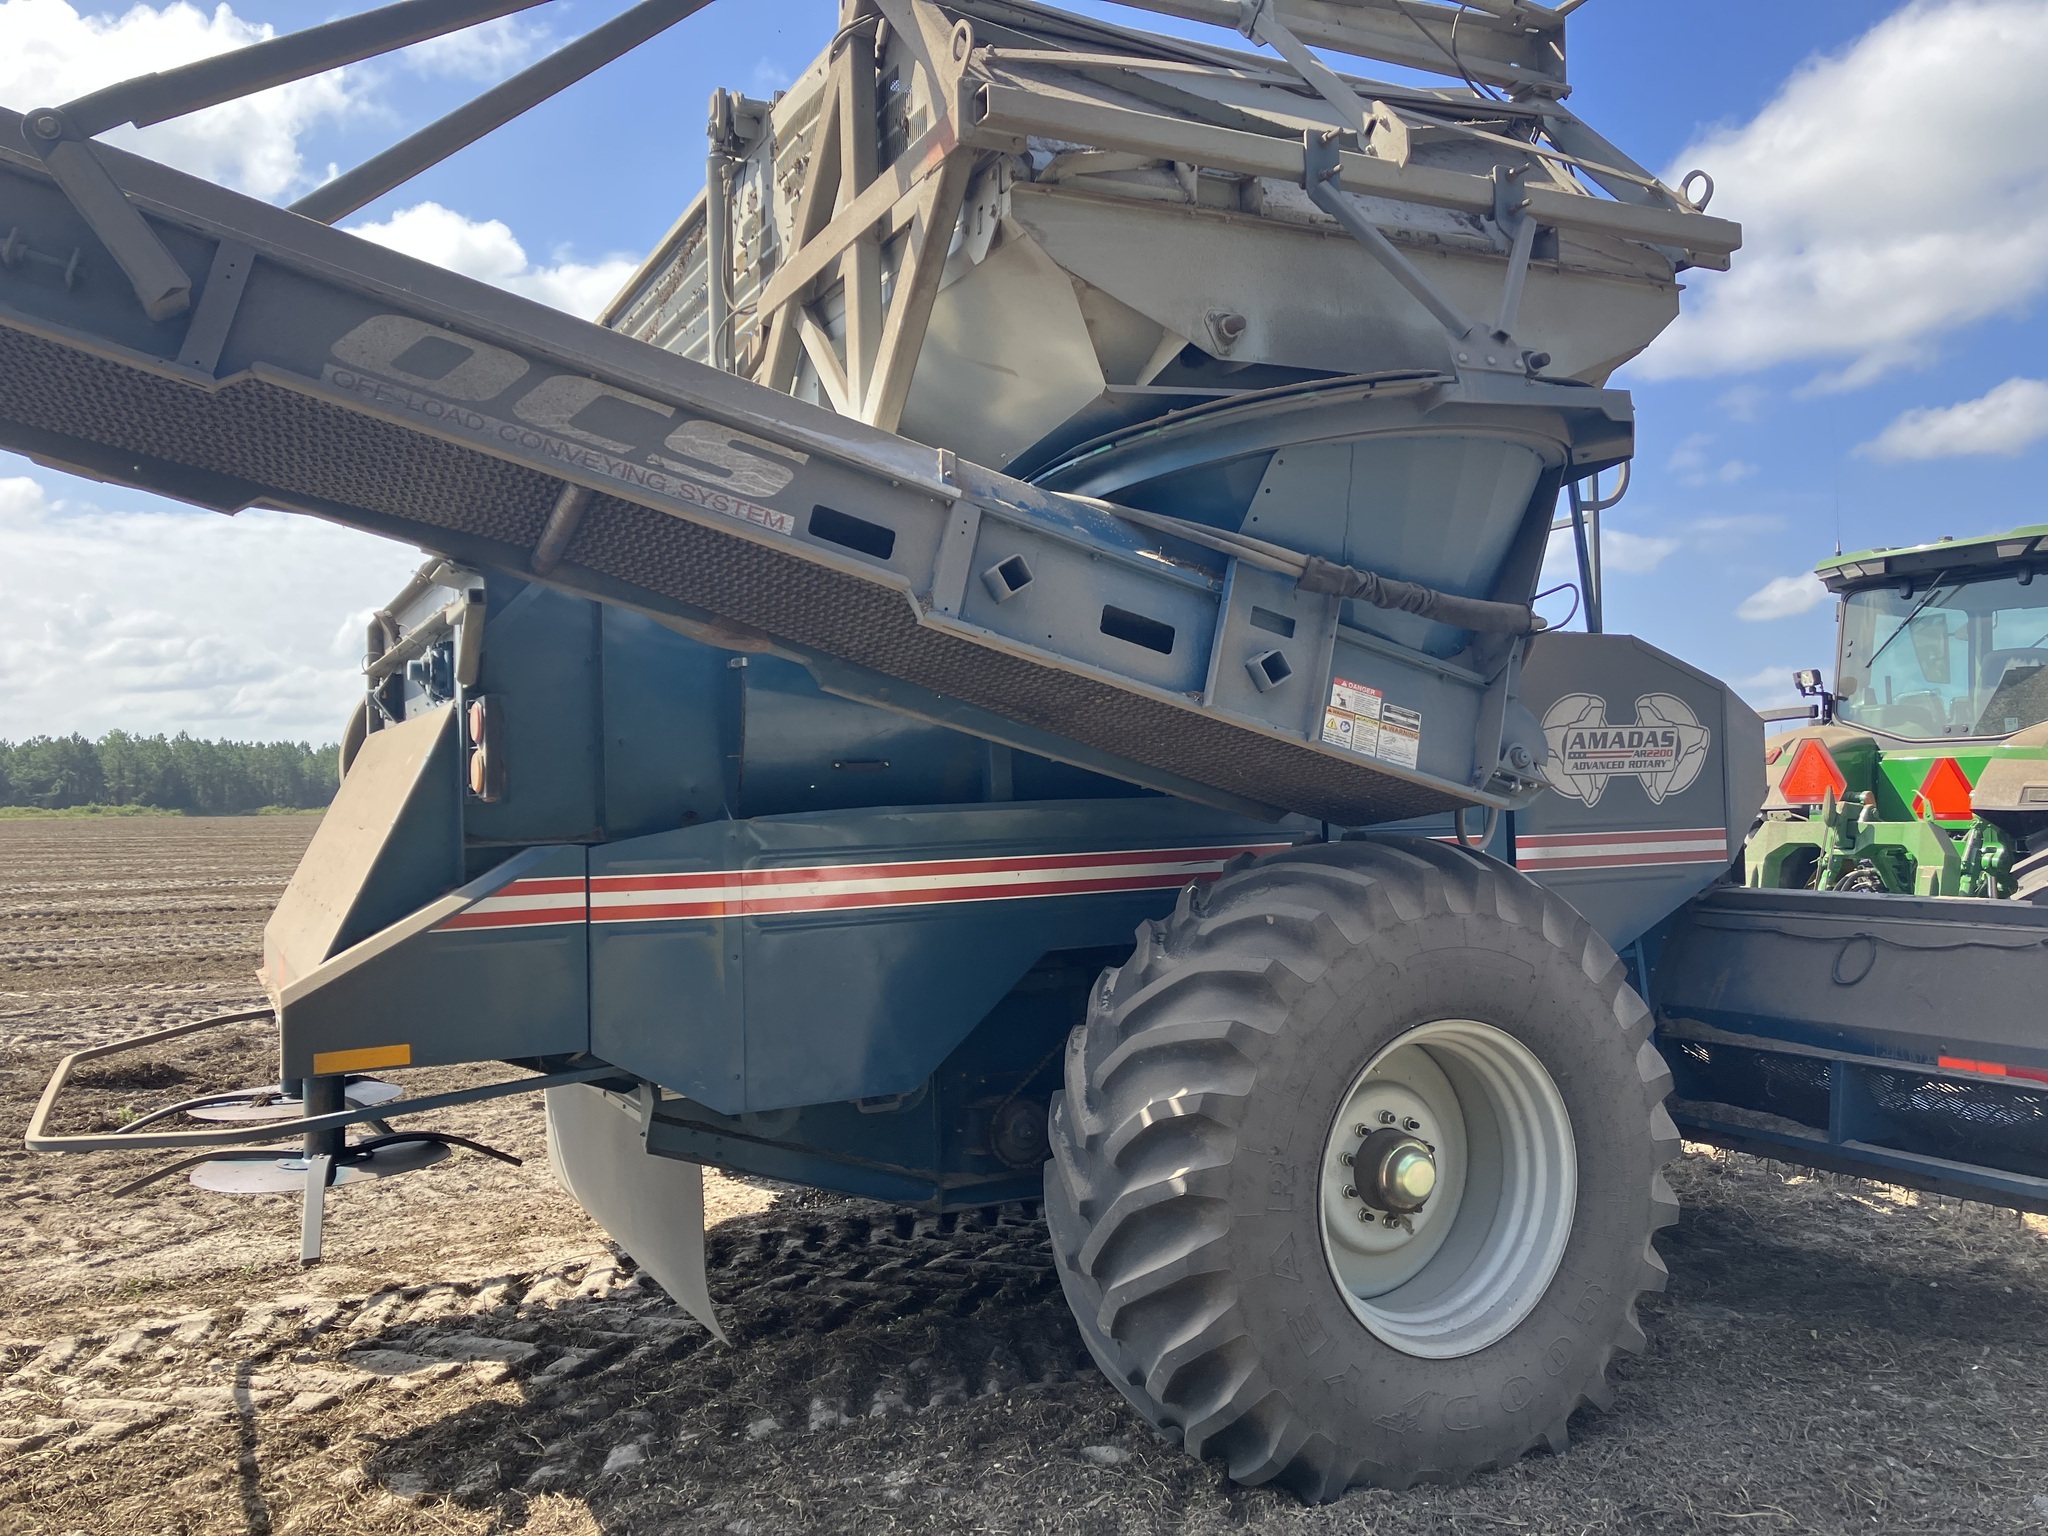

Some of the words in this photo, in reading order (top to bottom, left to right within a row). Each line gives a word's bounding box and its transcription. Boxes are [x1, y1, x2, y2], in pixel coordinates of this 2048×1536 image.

[330, 314, 811, 498] OCS
[499, 425, 668, 491] CONVEYING
[679, 483, 786, 530] SYSTEM
[1348, 682, 1376, 696] DANGER
[1388, 725, 1419, 740] WARNING
[1569, 731, 1675, 749] AMADAS
[1632, 749, 1674, 758] AR2200
[1571, 760, 1625, 770] ADVANCED
